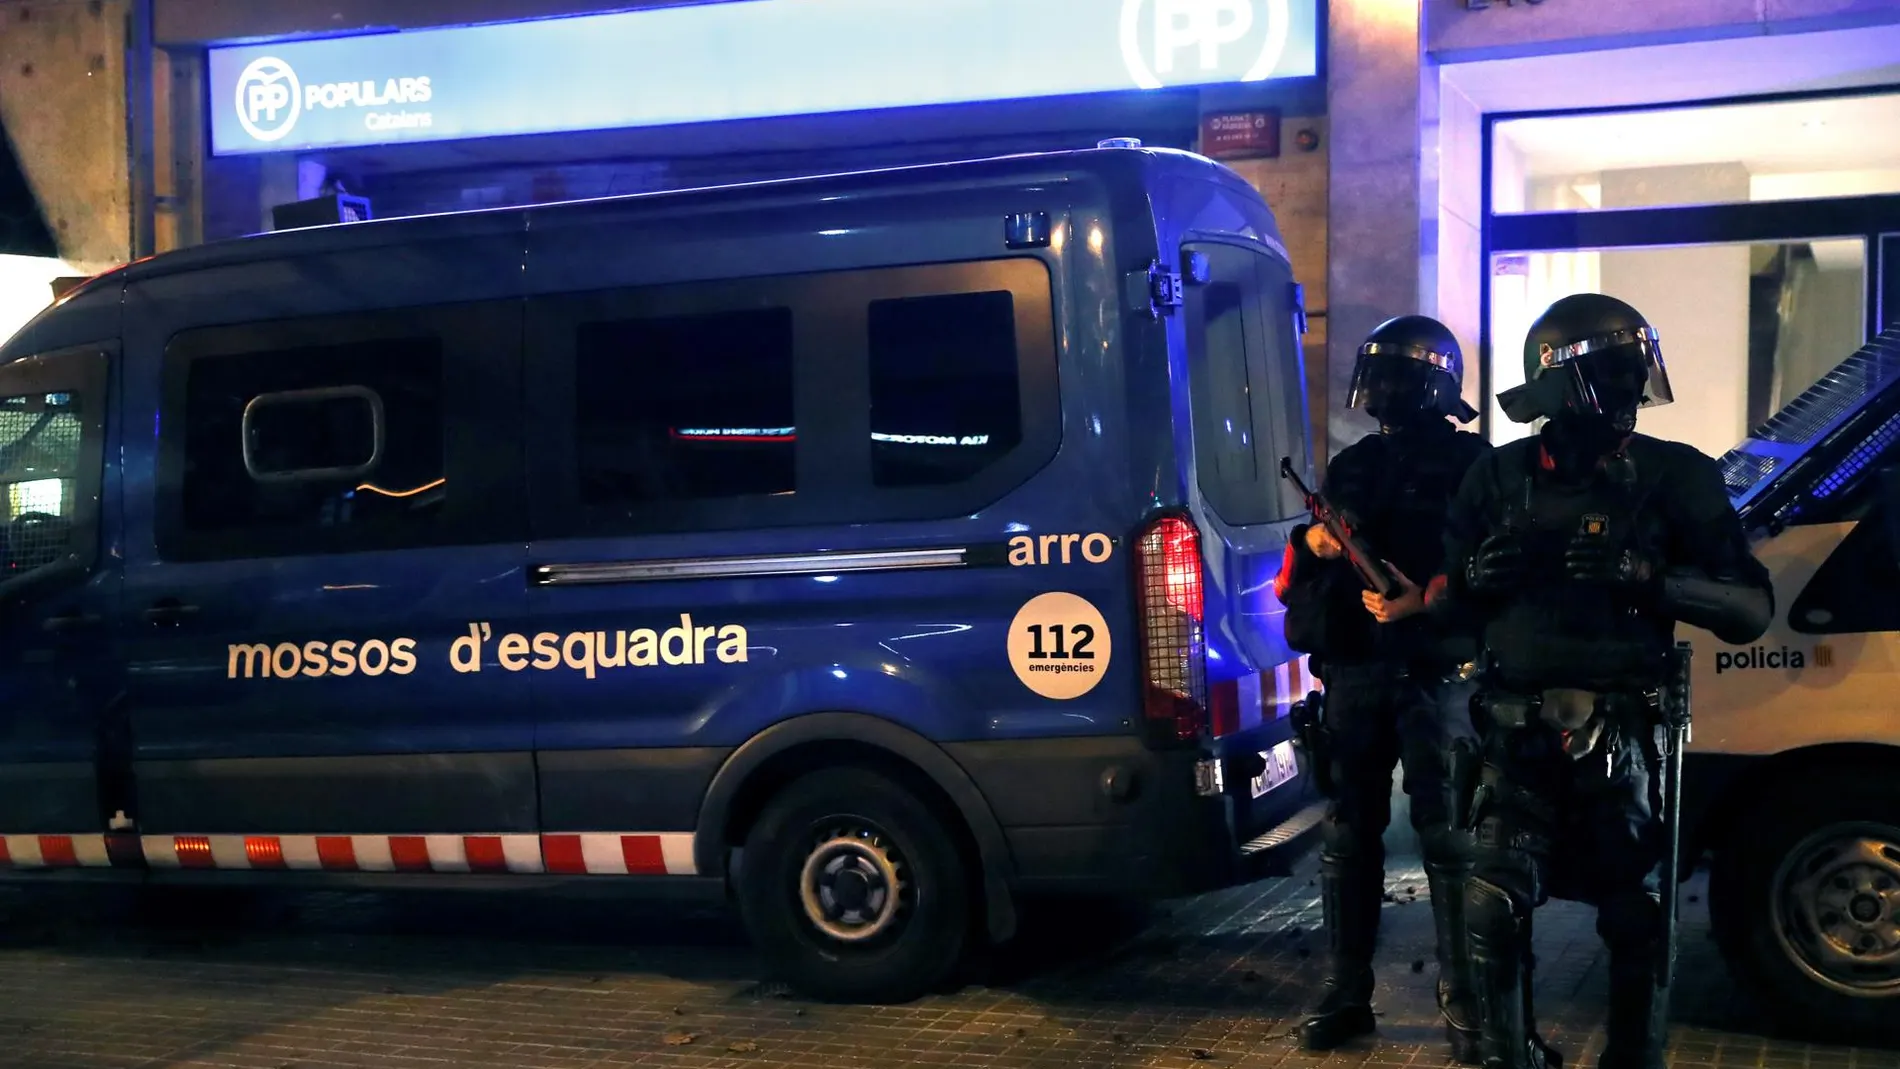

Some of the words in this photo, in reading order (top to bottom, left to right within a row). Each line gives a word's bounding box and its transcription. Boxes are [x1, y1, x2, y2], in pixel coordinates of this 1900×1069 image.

[1155, 0, 1253, 74] PP
[248, 83, 289, 122] PP
[304, 76, 432, 110] POPULARS
[365, 110, 432, 130] Catalans
[1008, 532, 1113, 566] arro
[229, 638, 416, 678] mossos
[1027, 624, 1095, 659] 112
[1029, 662, 1095, 674] emergències
[1716, 646, 1805, 674] policia
